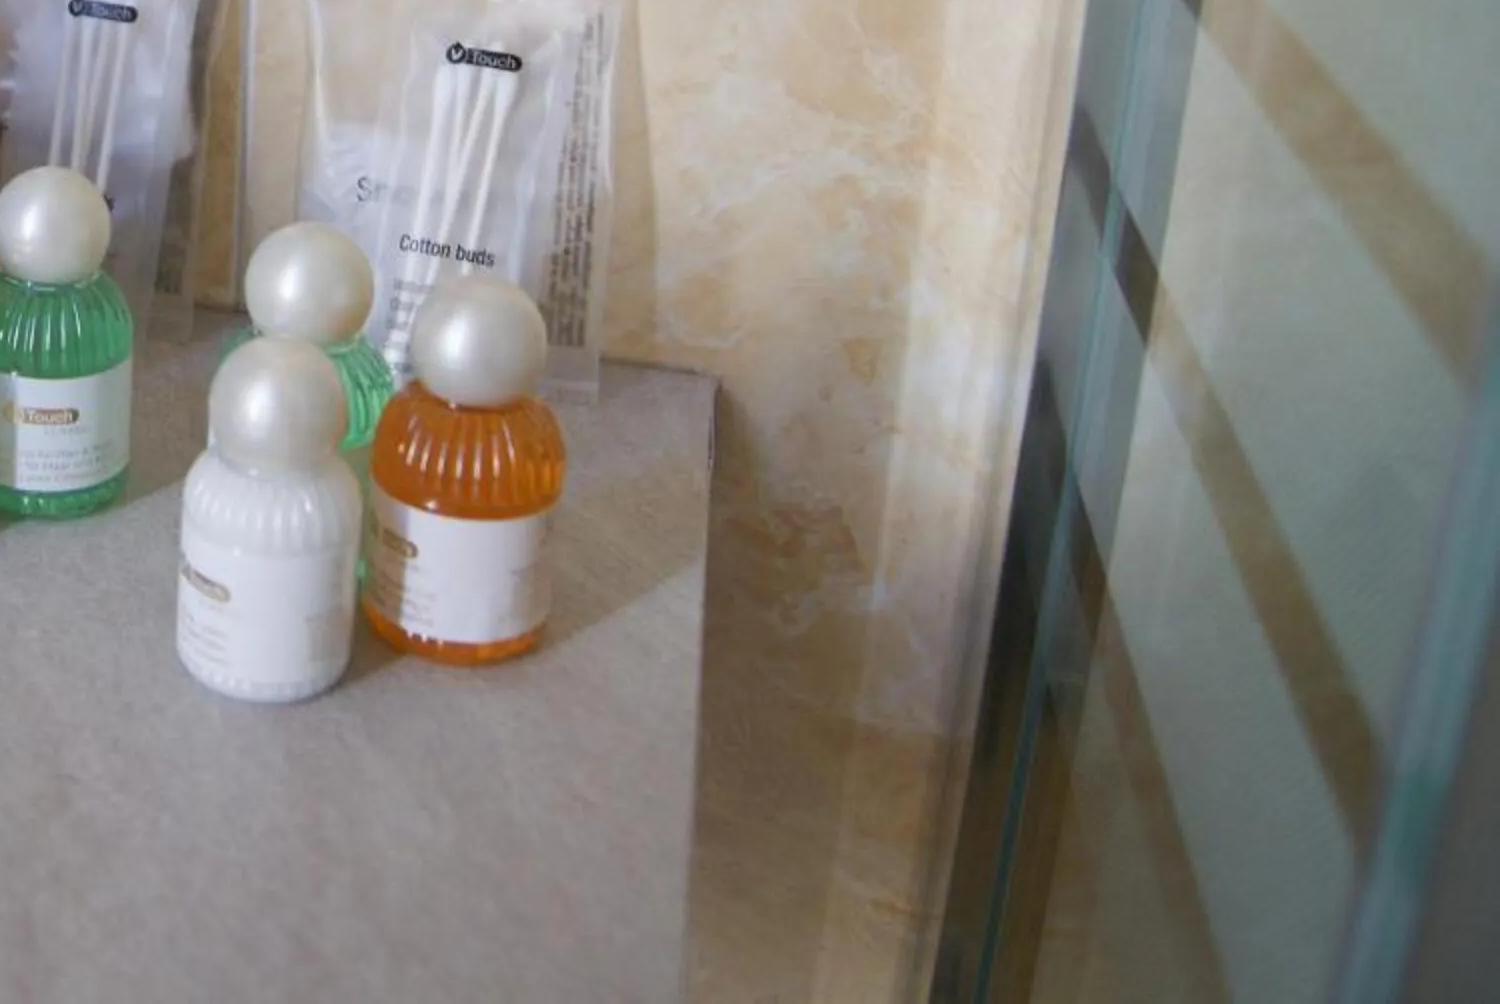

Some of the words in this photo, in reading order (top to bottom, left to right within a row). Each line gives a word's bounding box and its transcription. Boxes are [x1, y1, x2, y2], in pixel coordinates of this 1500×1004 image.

[472, 51, 518, 69] Touch
[399, 233, 452, 258] Cotton
[455, 243, 497, 268] buds
[26, 407, 75, 424] Touch
